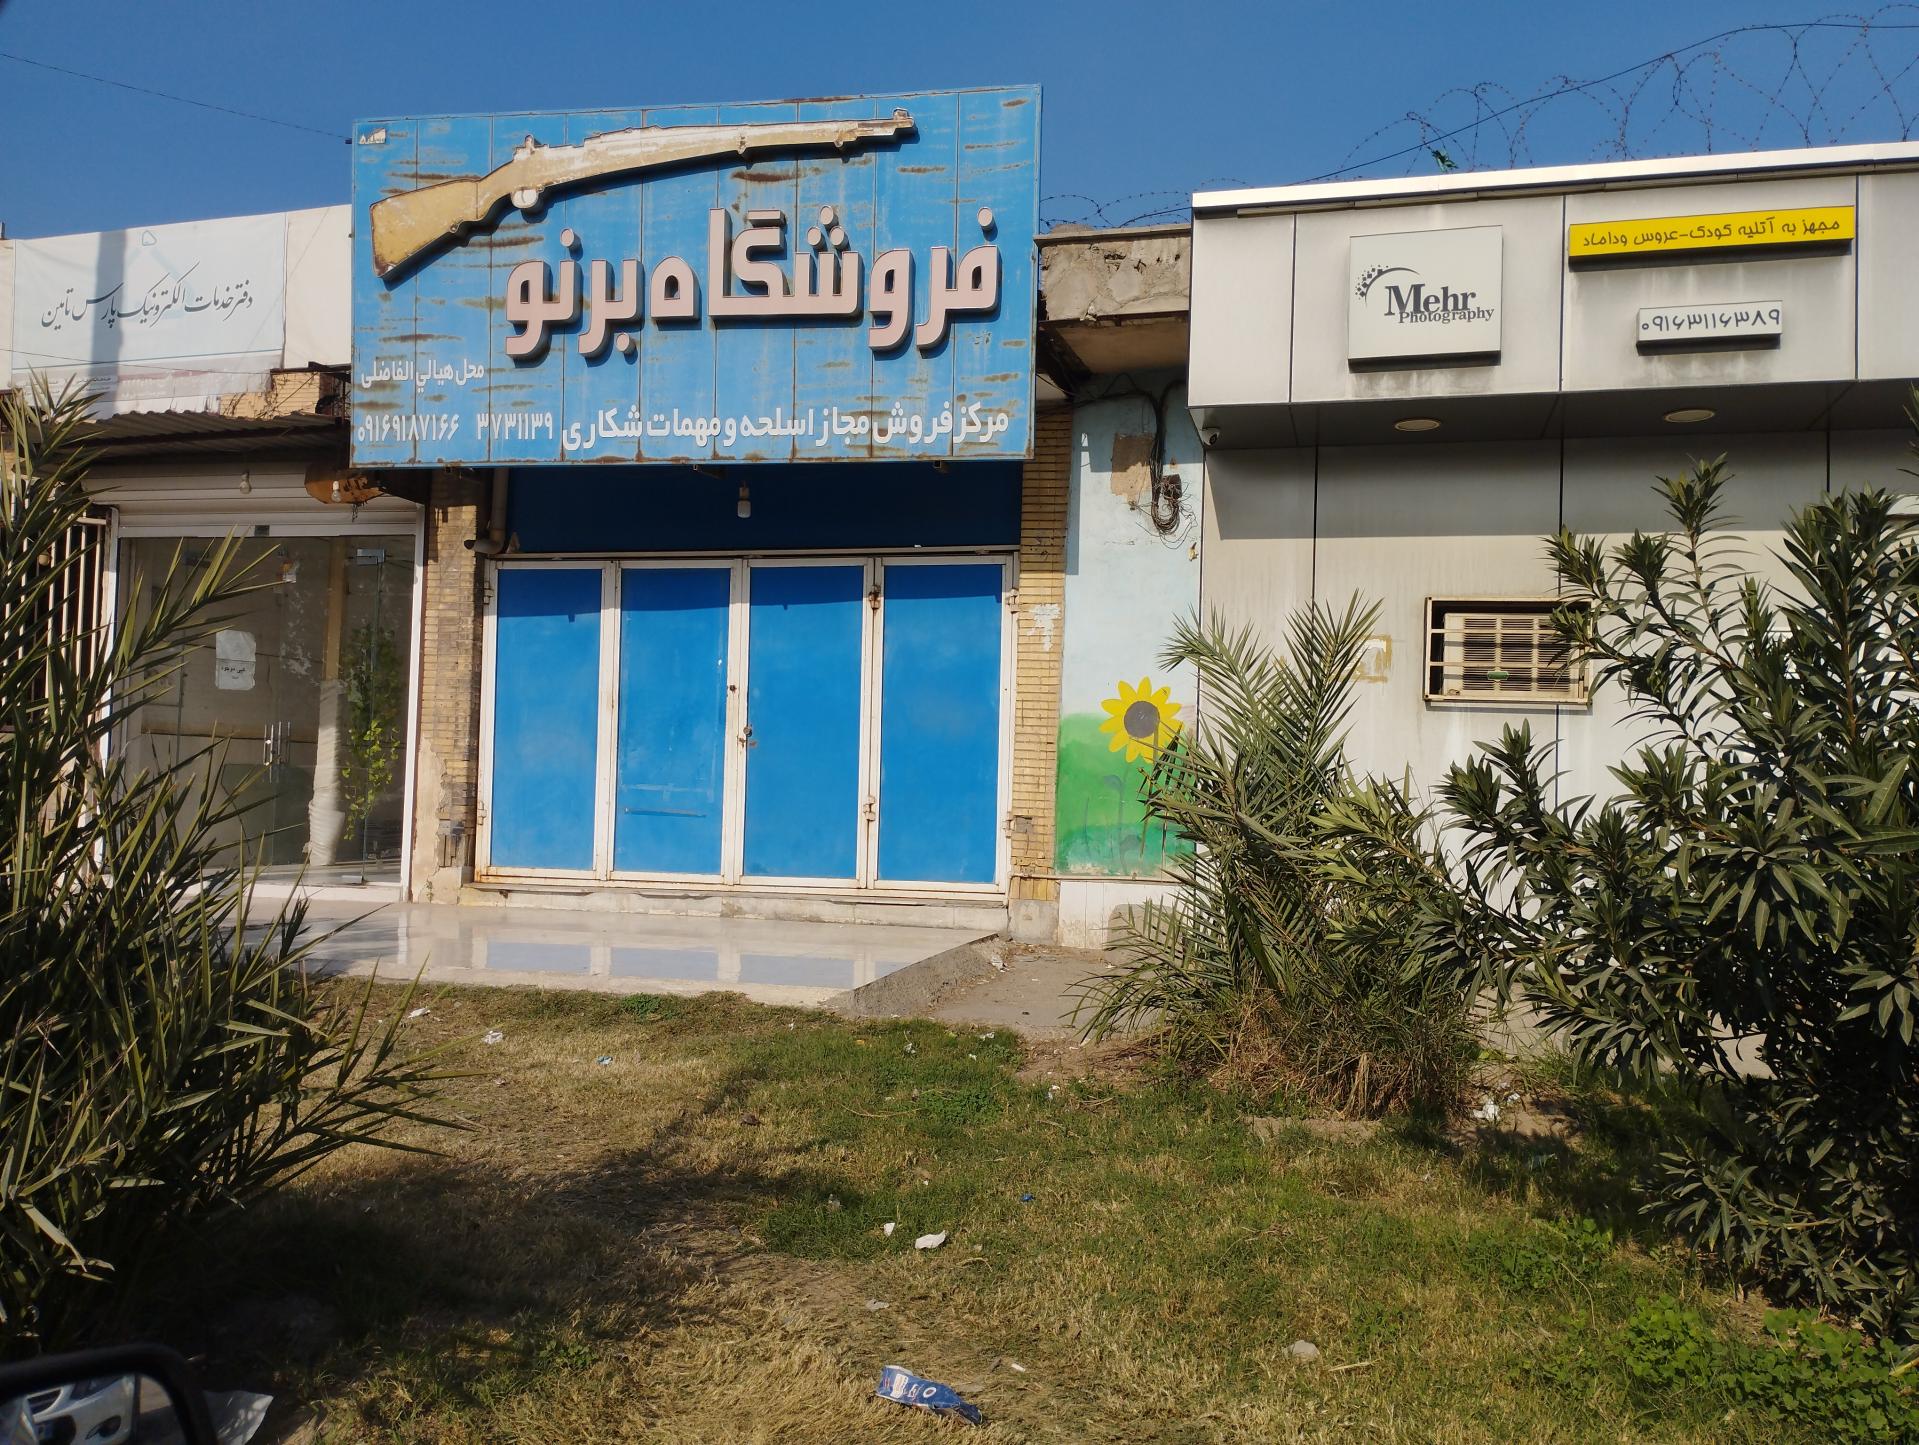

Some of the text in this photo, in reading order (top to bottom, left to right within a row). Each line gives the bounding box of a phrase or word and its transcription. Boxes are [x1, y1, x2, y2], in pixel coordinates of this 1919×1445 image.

[1737, 217, 1775, 239] آتلیه
[1781, 223, 1797, 235] به
[1802, 218, 1841, 233] مجهز
[116, 261, 200, 328] الکترونیک
[506, 205, 999, 355] فروشگاه برنو
[71, 282, 124, 328] پارس
[184, 285, 235, 312] خدمات
[223, 279, 254, 322] دفتر
[1384, 283, 1477, 316] Mehr
[1398, 307, 1495, 324] Photography
[1641, 308, 1780, 331] ۰۹۱۶۳۱۱۶۳۸۹
[455, 358, 485, 386] محل
[357, 411, 554, 442] ۳۷۳۱۱۳۹ ۰۹۱۶۹۱۸۷۱۶۶
[562, 404, 643, 451] شکاری
[646, 408, 721, 447] مهمات
[740, 407, 814, 438] اسلحه
[815, 407, 871, 447] مجاز
[872, 401, 953, 445] فروش
[952, 401, 1009, 444] مرکز
